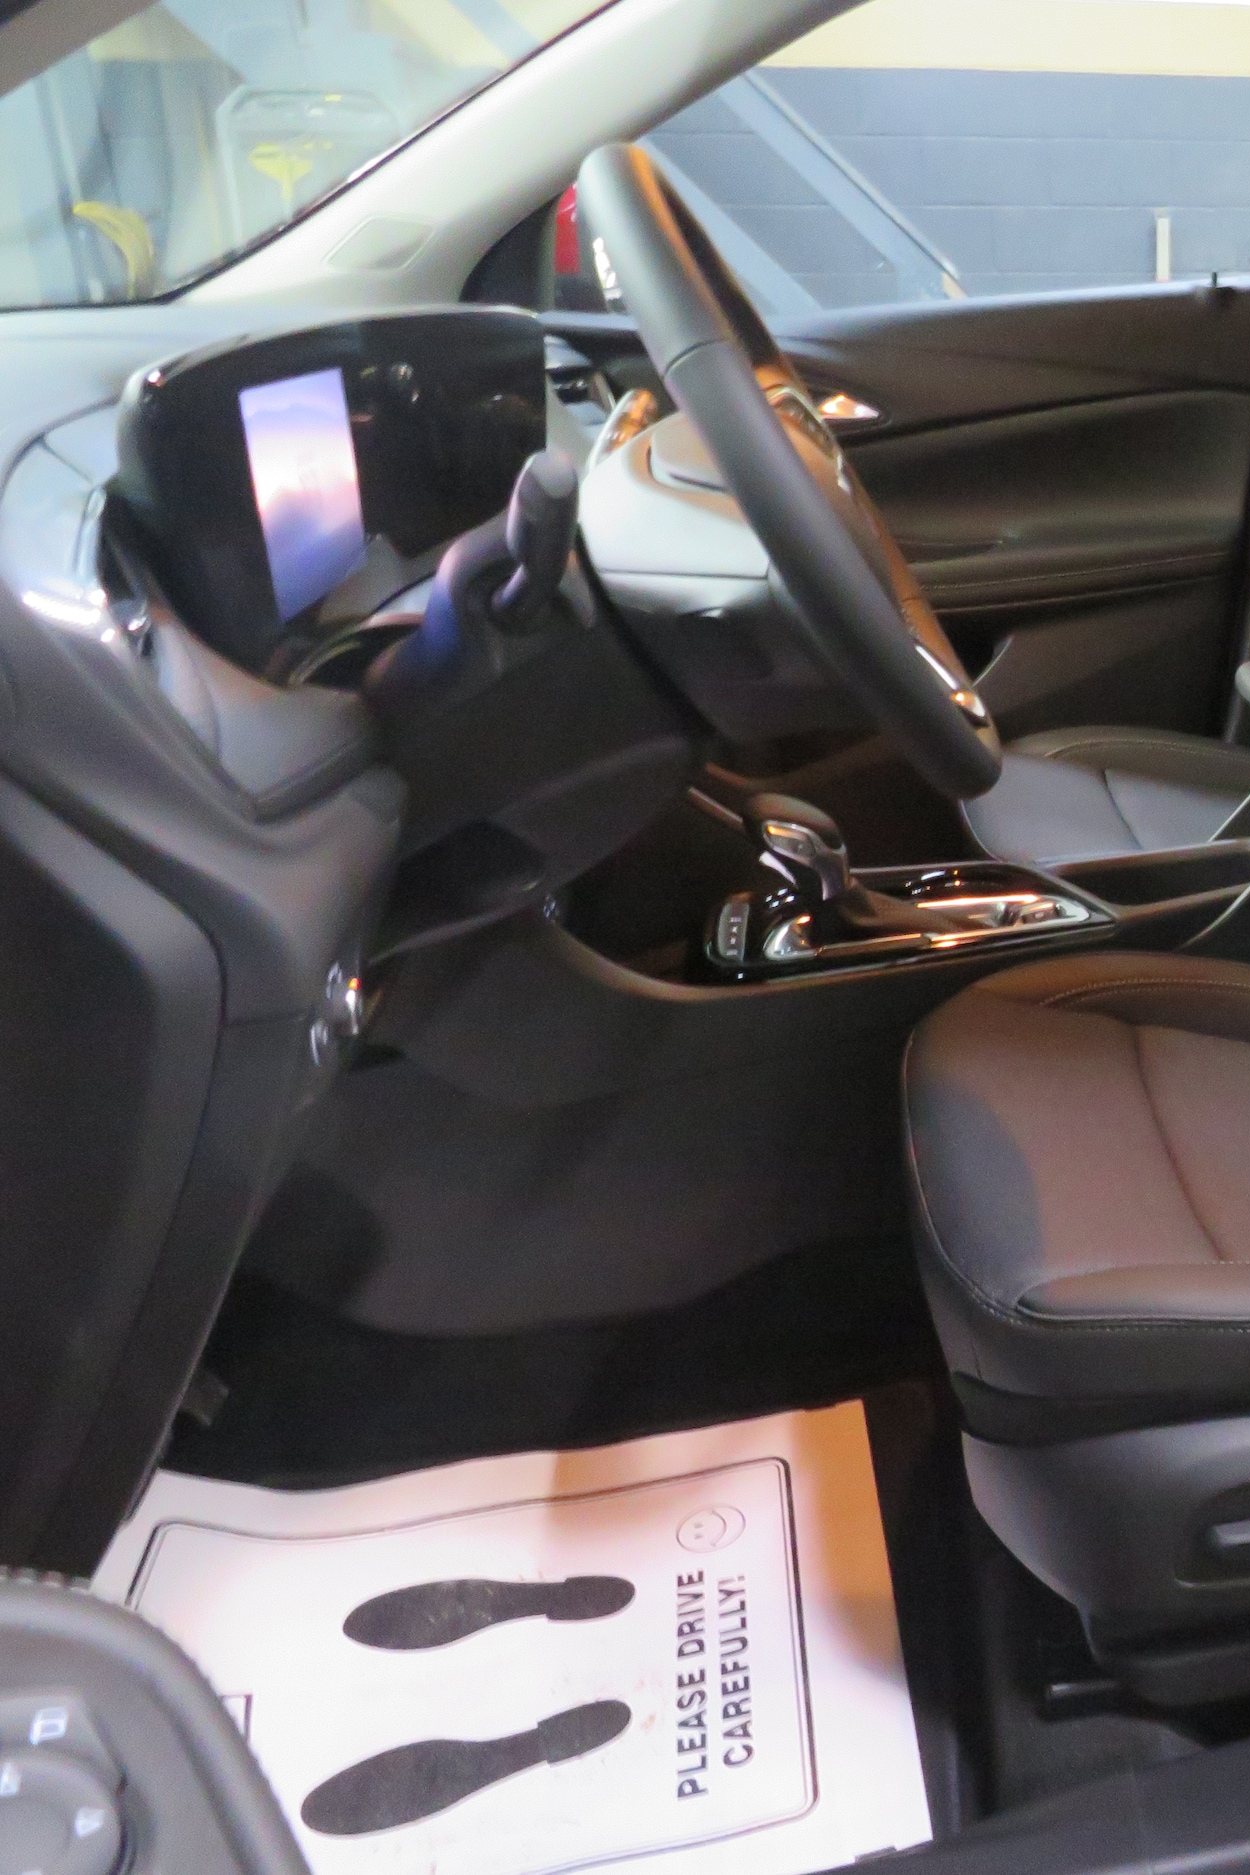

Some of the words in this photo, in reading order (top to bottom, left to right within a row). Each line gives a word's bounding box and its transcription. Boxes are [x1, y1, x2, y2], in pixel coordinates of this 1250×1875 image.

[676, 1569, 706, 1659] DRIVE
[718, 1574, 755, 1767] CAREFULLY!
[677, 1668, 708, 1800] PLEASE
